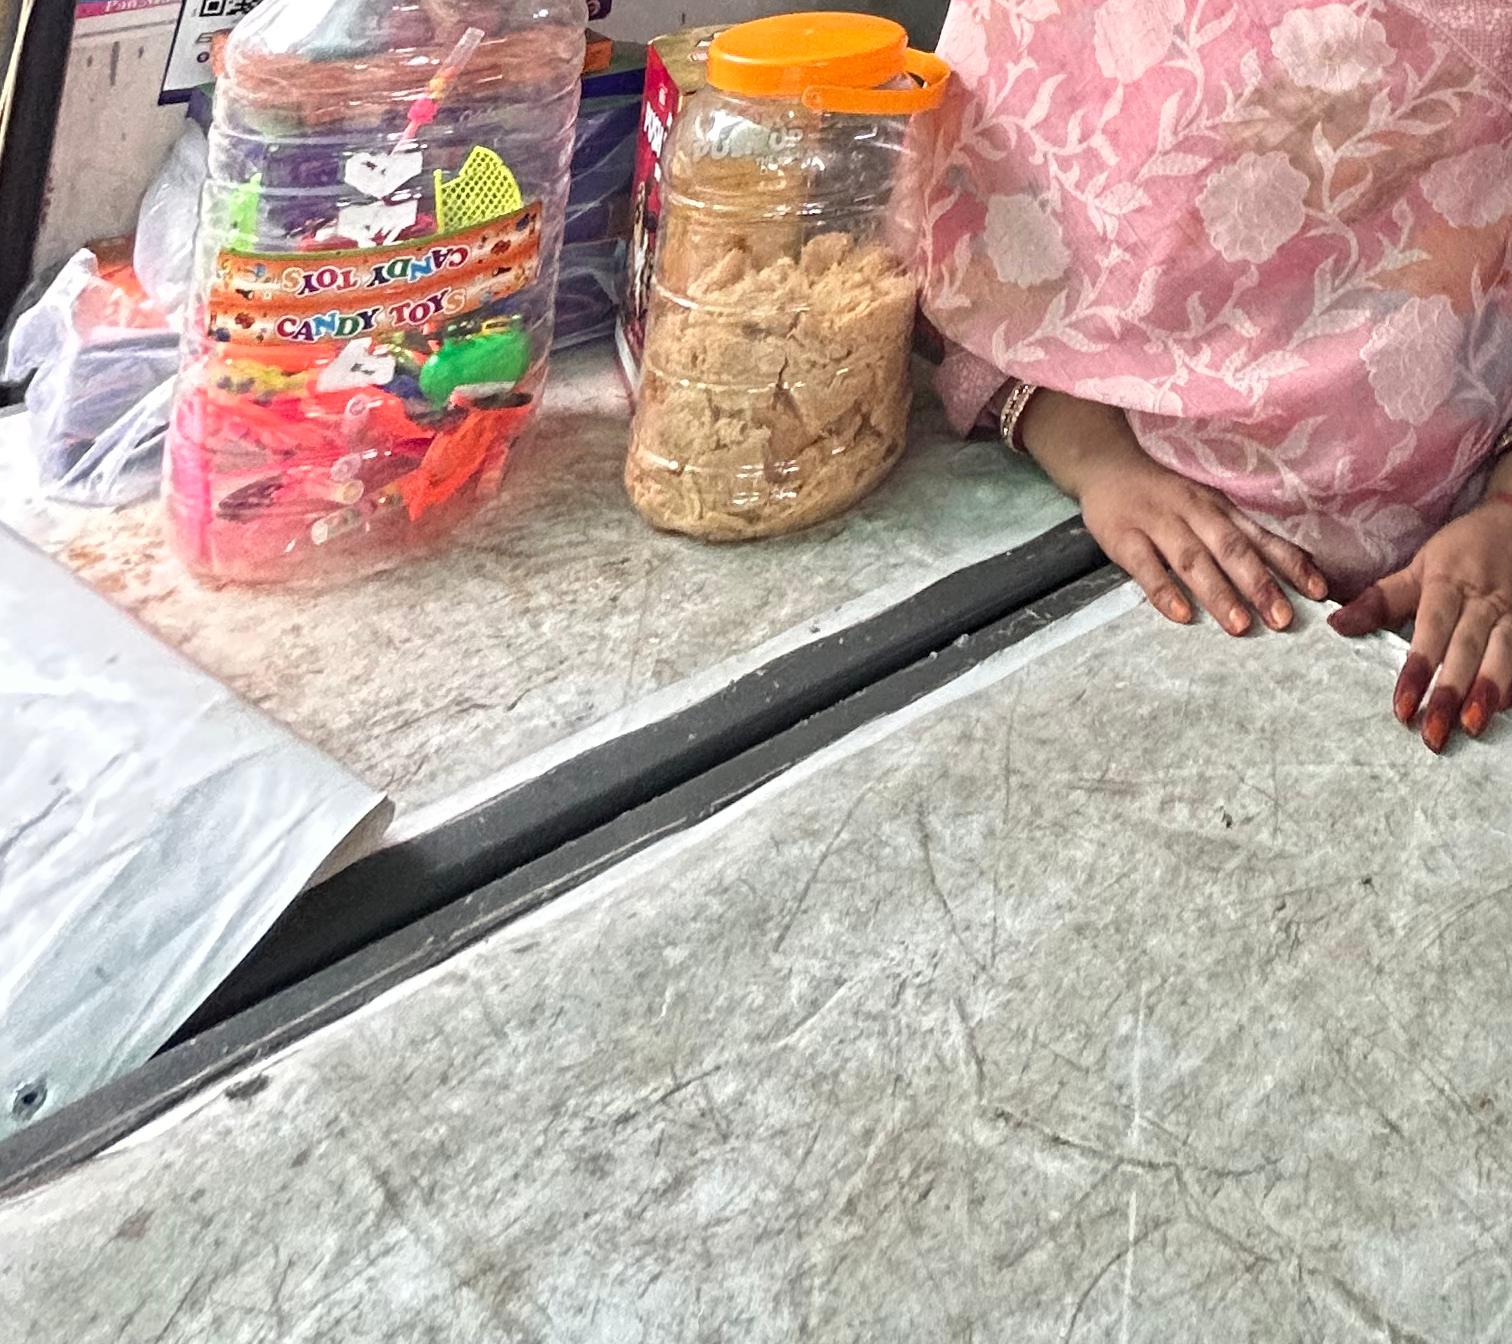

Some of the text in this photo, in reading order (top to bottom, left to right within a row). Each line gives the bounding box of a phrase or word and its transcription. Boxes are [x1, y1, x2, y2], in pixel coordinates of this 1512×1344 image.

[281, 245, 471, 297] CANDY TOYS
[274, 286, 468, 342] CANDY TOYS
